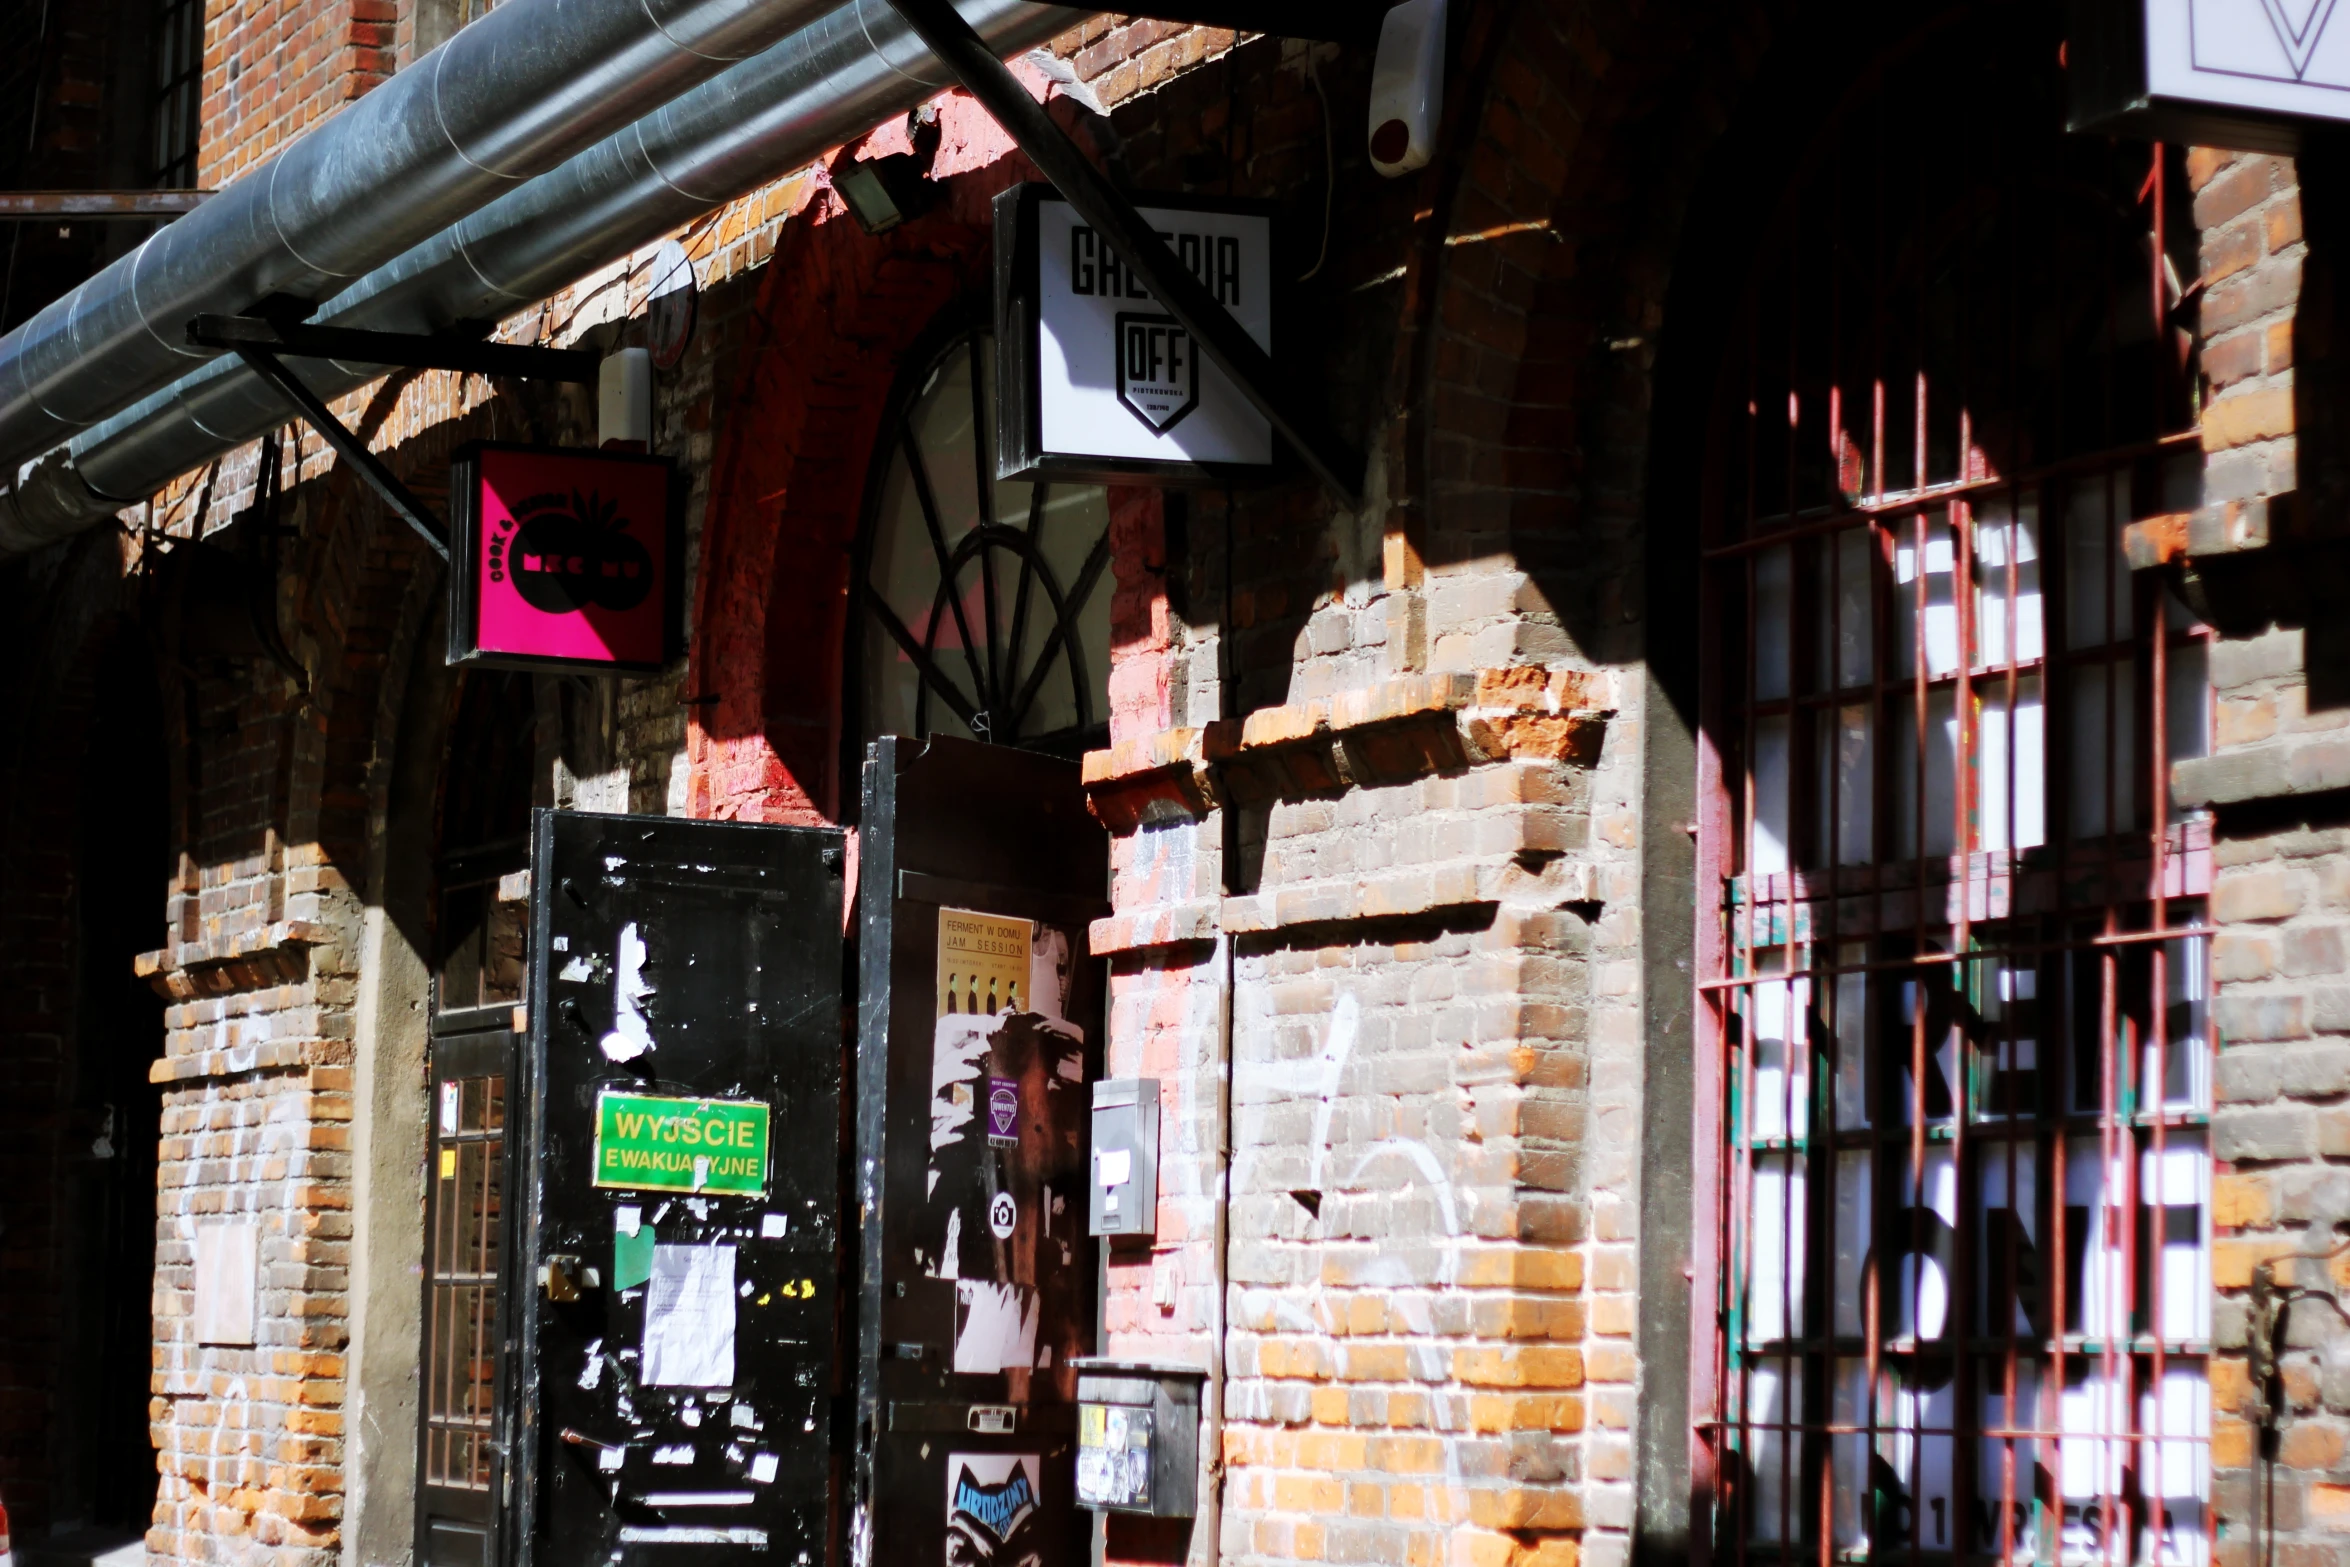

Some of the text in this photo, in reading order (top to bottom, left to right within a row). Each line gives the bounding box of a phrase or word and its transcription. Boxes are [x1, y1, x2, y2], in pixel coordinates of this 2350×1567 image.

[1072, 226, 1240, 306] GALRIA
[1127, 326, 1187, 383] OFF
[1132, 387, 1184, 397] PIOTRKOWSKA
[489, 532, 508, 583] COOK
[946, 920, 983, 934] FERMENT
[987, 926, 995, 936] W
[946, 936, 1023, 955] JAM SESSION
[957, 1477, 1029, 1525] URODZINY
[1930, 1497, 1946, 1545] 1
